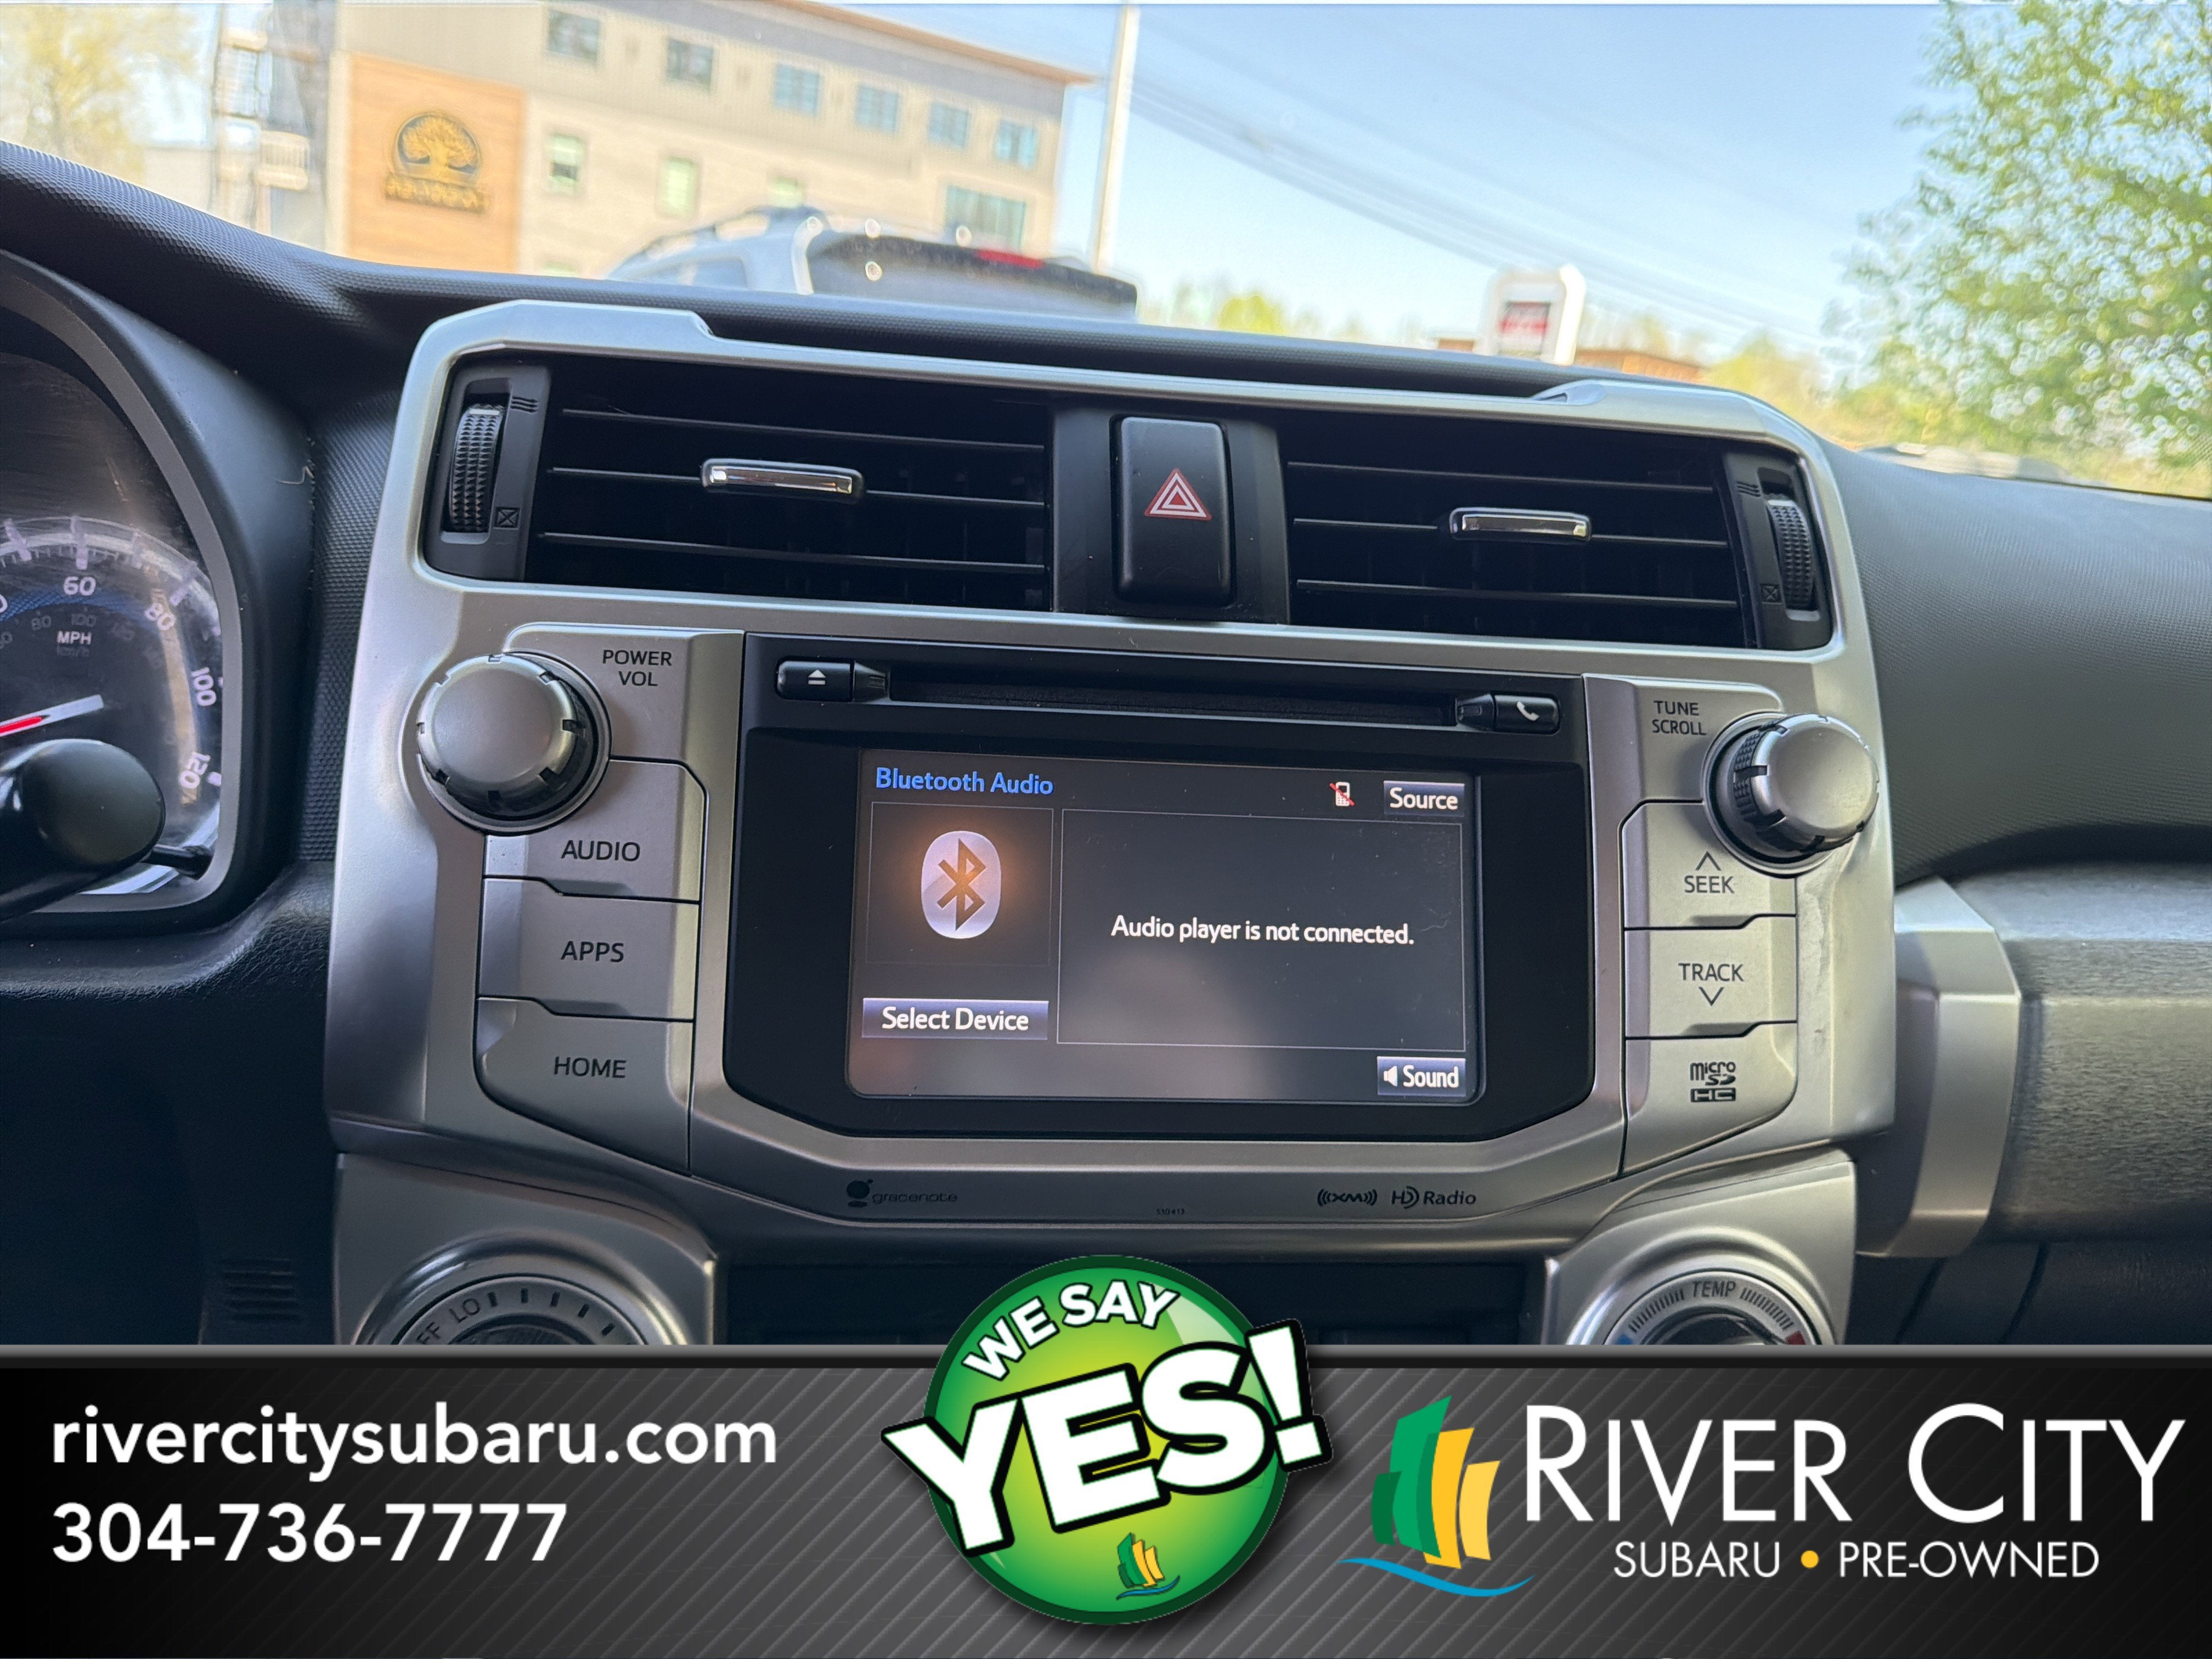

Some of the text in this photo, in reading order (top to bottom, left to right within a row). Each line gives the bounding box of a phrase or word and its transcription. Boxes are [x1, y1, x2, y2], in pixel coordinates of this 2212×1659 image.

[63, 576, 97, 596] 60
[144, 603, 176, 631] 80
[57, 631, 92, 645] MPH
[602, 649, 673, 667] POWER
[191, 667, 217, 707] 100
[618, 670, 658, 687] VOL
[1653, 700, 1700, 716] TUNE
[1651, 719, 1706, 736] SCROLL
[178, 752, 211, 789] 120
[876, 767, 1054, 795] Bluetooth Audio
[1390, 787, 1459, 810] Source
[561, 839, 641, 862] AUDIO
[1684, 874, 1734, 894] SEEK
[1110, 914, 1414, 945] Audio player is not connected.
[561, 940, 624, 963] APPS
[1678, 963, 1745, 982] TRACK
[882, 1006, 1029, 1031] Select Device
[554, 1056, 627, 1079] HOME
[1402, 1064, 1459, 1088] Sound
[872, 1192, 958, 1205] gracenote
[1391, 1186, 1477, 1209] HD Radio
[1691, 1280, 1736, 1299] TEMP
[449, 1298, 480, 1323] LO
[416, 1321, 441, 1345] FF
